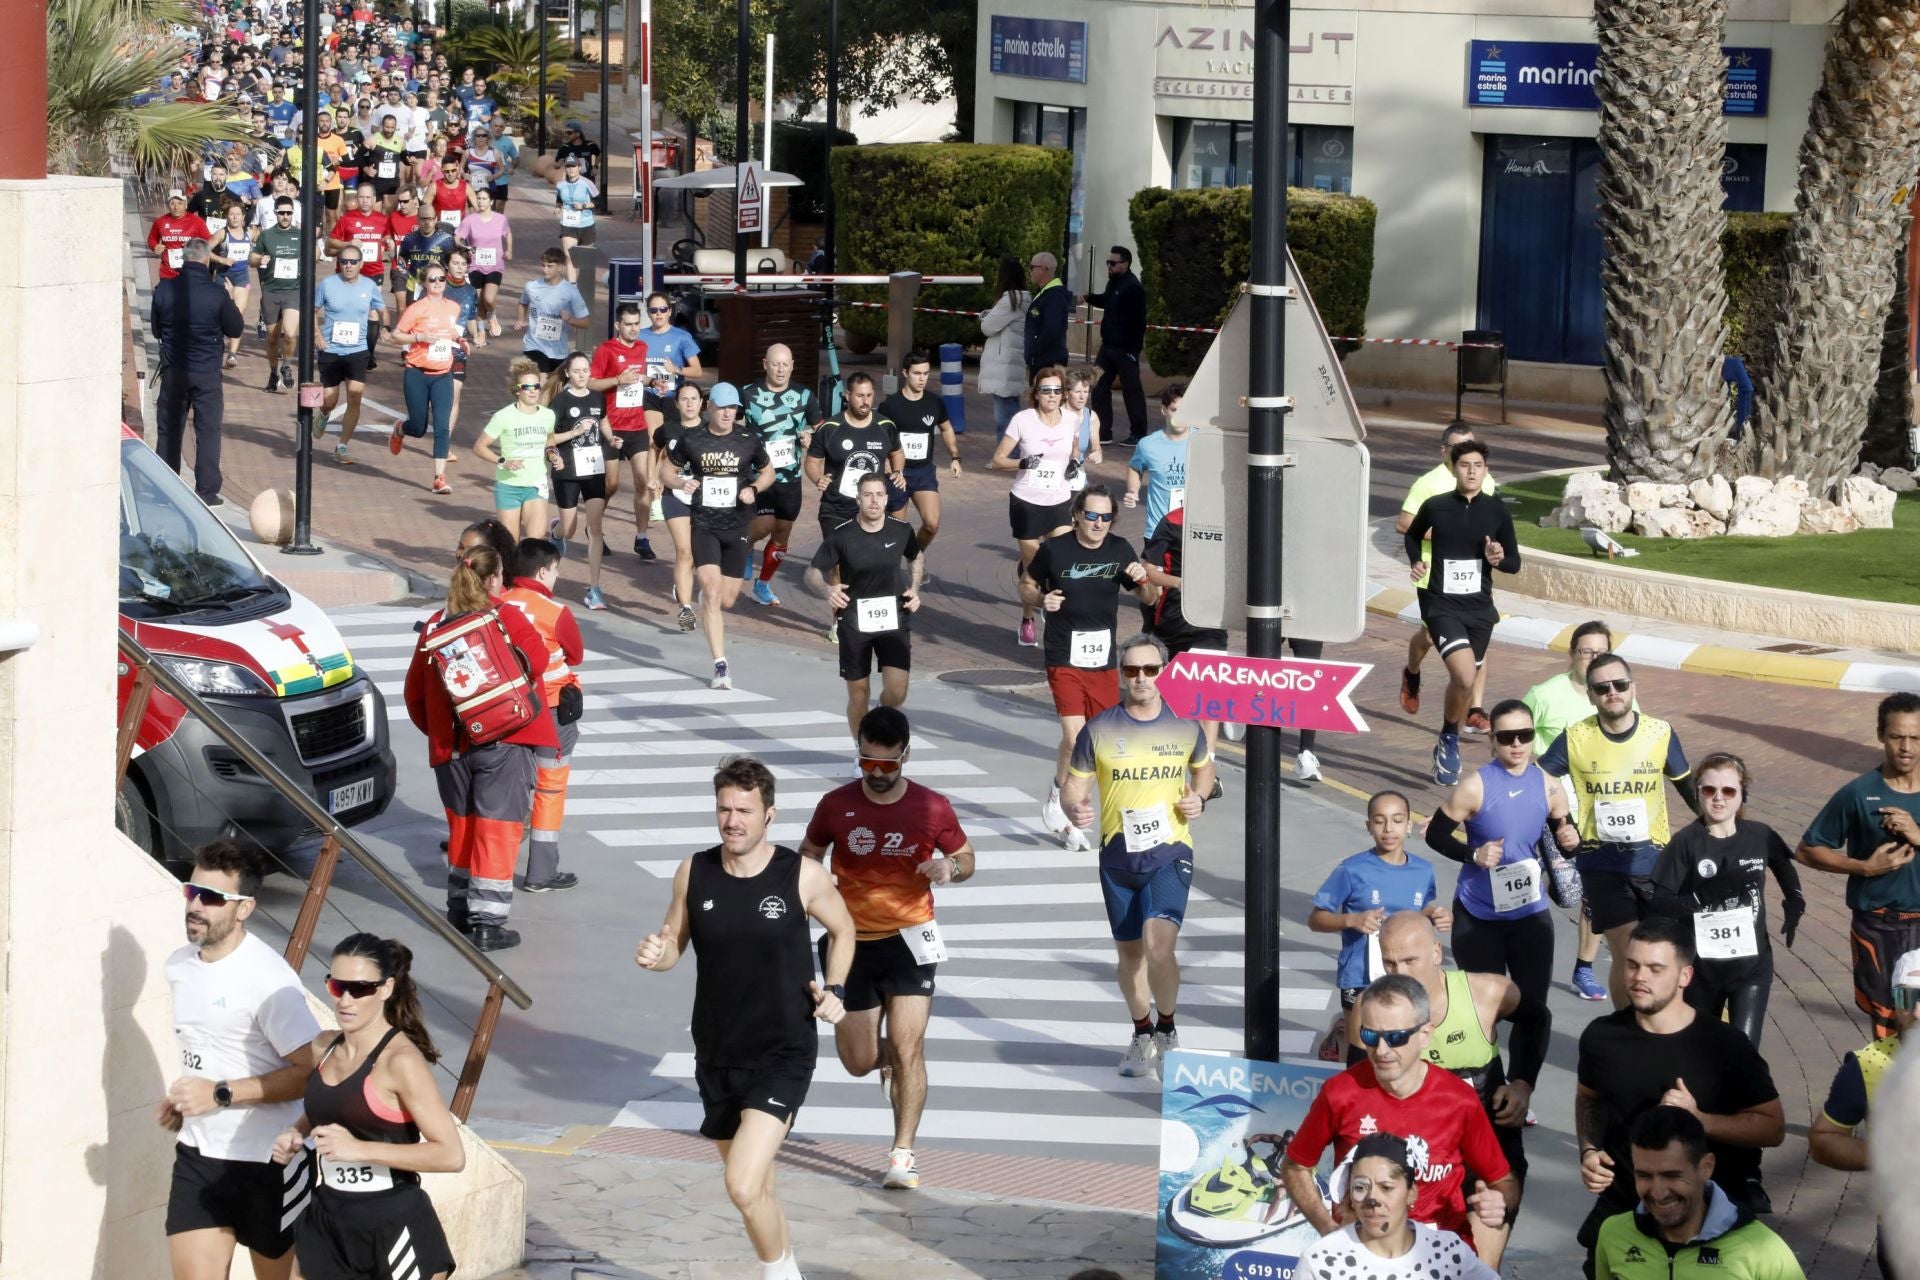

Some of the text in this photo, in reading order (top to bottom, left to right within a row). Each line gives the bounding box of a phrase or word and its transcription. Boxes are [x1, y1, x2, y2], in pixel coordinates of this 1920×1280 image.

[1154, 25, 1353, 54] AZIUT
[1004, 33, 1066, 60] marina estrella
[1478, 73, 1507, 82] marina
[1154, 78, 1353, 102] EXCLUSIVE ALER
[1477, 81, 1508, 91] estrella
[1726, 82, 1757, 91] marina
[1724, 90, 1757, 99] estrella
[338, 329, 354, 337] 231
[542, 324, 558, 333] 374
[654, 373, 670, 381] 339
[623, 390, 639, 398] 427
[904, 442, 923, 450] 169
[774, 448, 792, 458] 367
[585, 455, 597, 463] 14
[1036, 469, 1056, 479] 327
[710, 487, 730, 497] 316
[1192, 531, 1223, 541] BAN
[1453, 571, 1475, 581] 357
[867, 608, 889, 619] 199
[1080, 643, 1103, 654] 134
[1189, 692, 1298, 725] Jet Ski
[1112, 766, 1183, 781] BALEARIA
[1586, 781, 1657, 795] BALEARIA
[335, 787, 356, 809] 4957
[1132, 819, 1161, 835] 359
[1607, 816, 1637, 828] 398
[883, 832, 904, 849] 29
[1505, 876, 1532, 892] 164
[1709, 925, 1742, 941] 381
[183, 1049, 203, 1070] 332
[1174, 1063, 1326, 1099] MAREMOT
[336, 1165, 374, 1184] 335
[1248, 1264, 1273, 1277] 619
